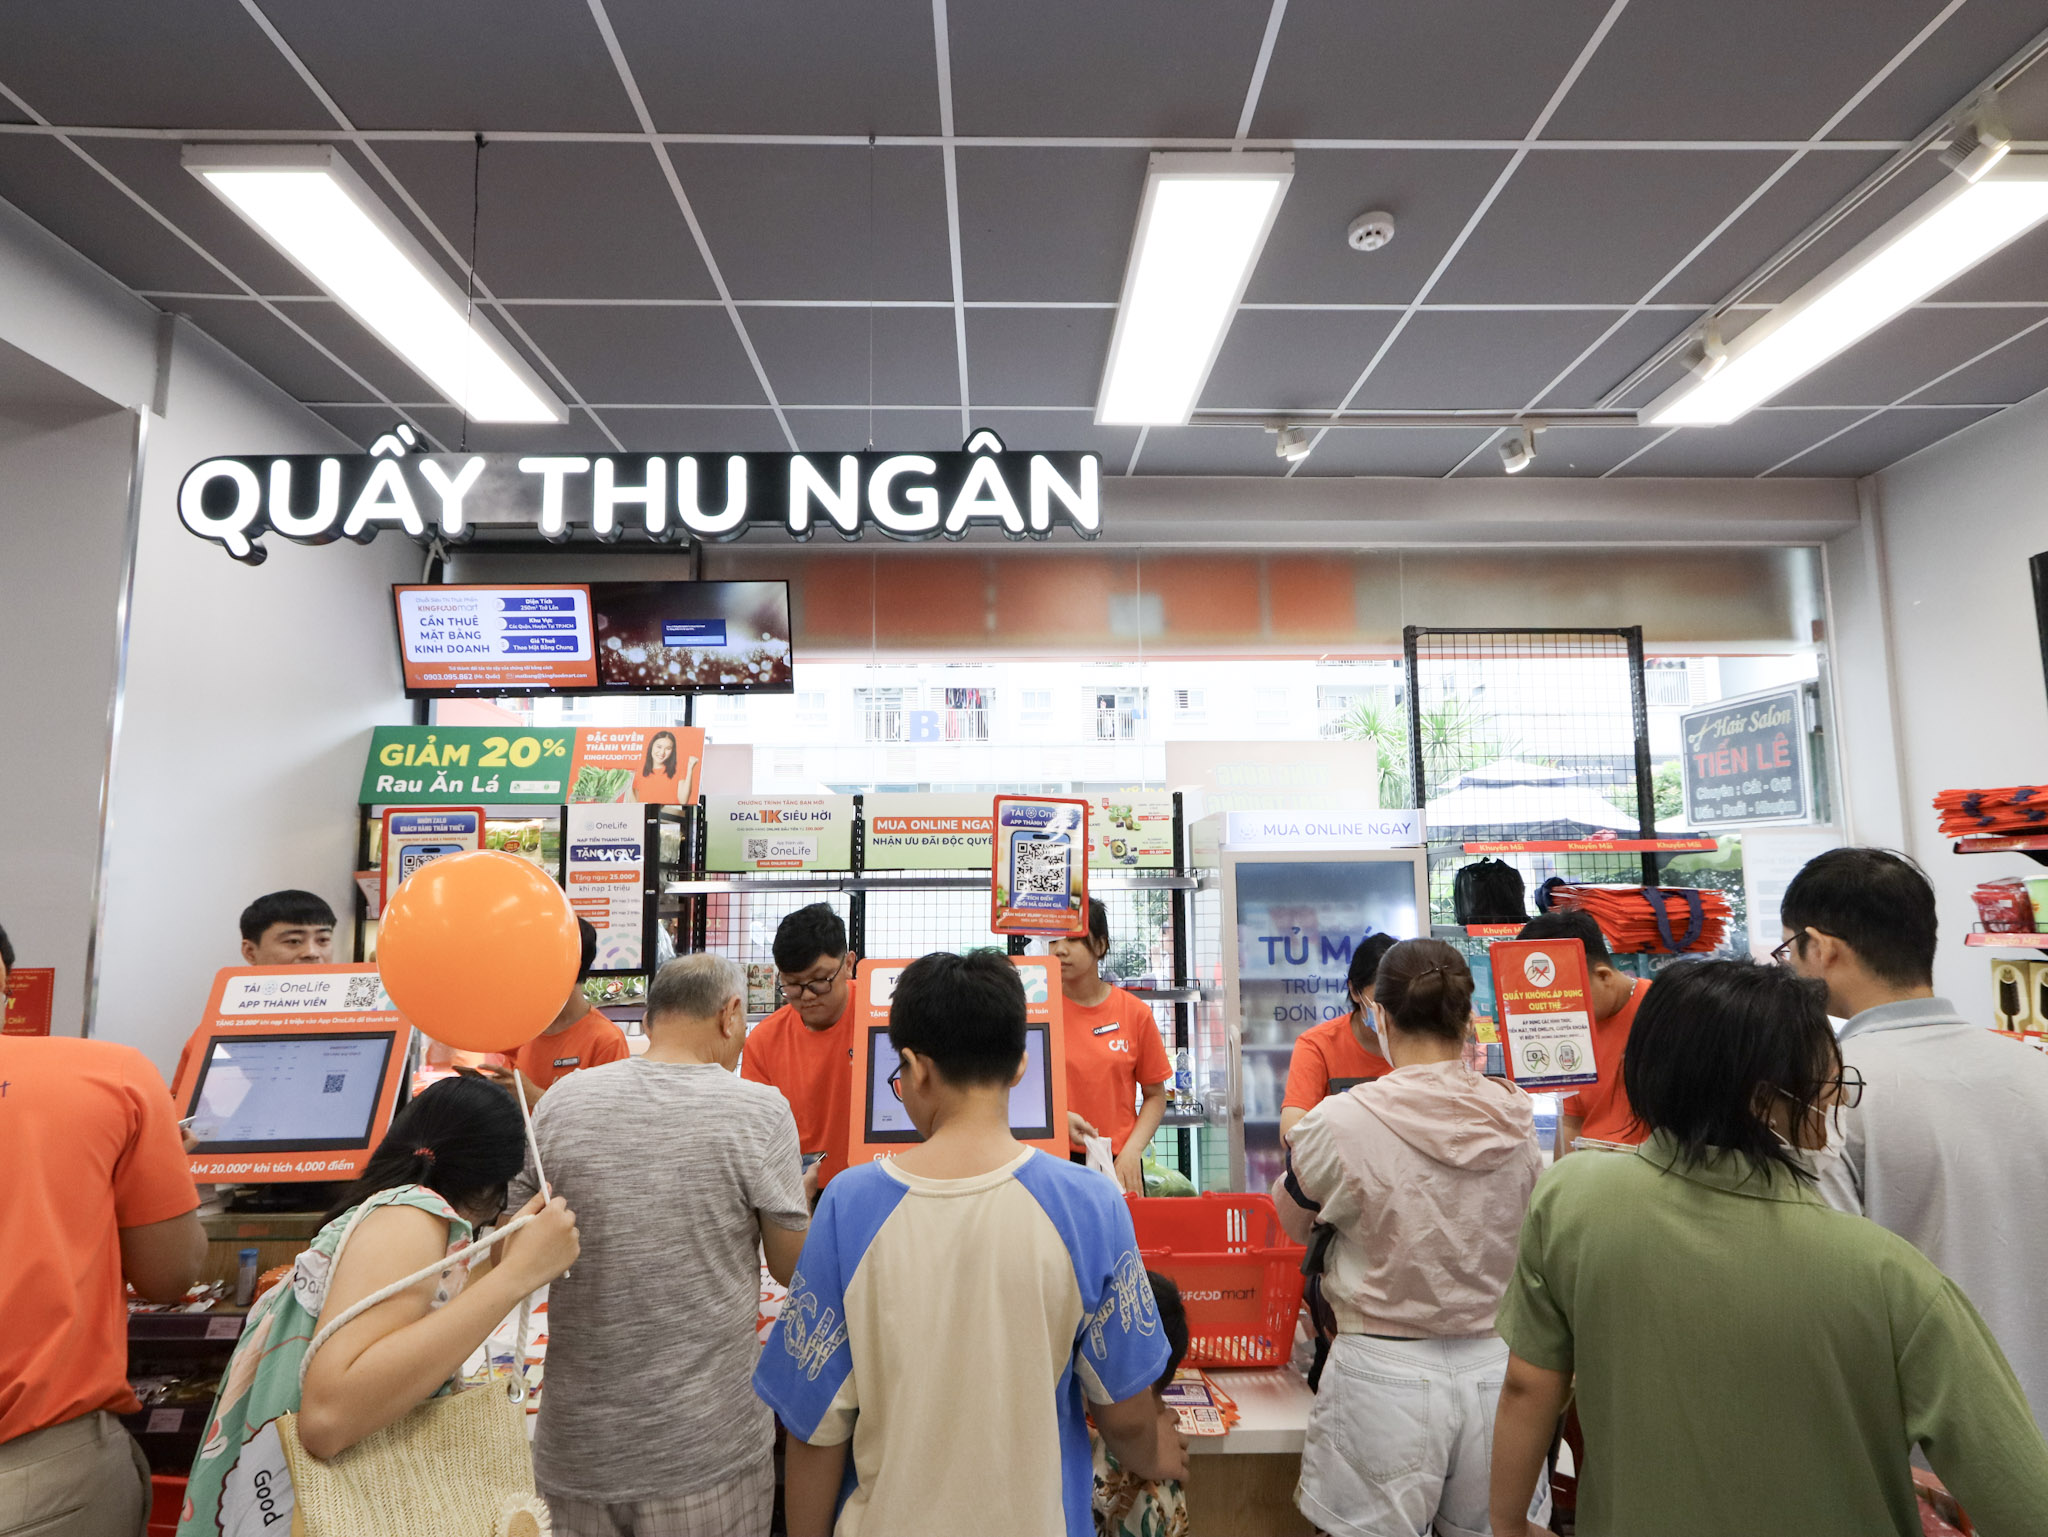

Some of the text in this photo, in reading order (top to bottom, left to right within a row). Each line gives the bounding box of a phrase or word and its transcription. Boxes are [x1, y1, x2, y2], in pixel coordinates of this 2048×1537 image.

[179, 423, 1100, 558] QUẦY THU NGÂN
[447, 614, 479, 626] THUÊ
[420, 627, 482, 643] MẶT BẰNG
[414, 644, 490, 654] KINH DOANH
[909, 710, 941, 743] B
[1713, 703, 1792, 739] Hair Salon
[586, 730, 644, 744] ĐẶC QUYỀN
[379, 734, 566, 768] GIẢM 20%
[586, 742, 643, 751] THÀNH VIÊN
[1693, 731, 1792, 779] TIẾN LÊ
[375, 770, 500, 793] Rau Ăn Lá
[729, 809, 832, 824] DEAL 1K SIÊU HỜI
[1009, 808, 1024, 817] TẢI
[595, 821, 628, 830] OneLife
[876, 819, 907, 830] MUA
[910, 819, 959, 830] ONLINE
[1263, 822, 1411, 836] MUA ONLINE NGAY
[872, 835, 964, 848] NHẬN ƯU ĐÃI ĐỘC
[1479, 843, 1525, 852] Khuyến Mãi
[1567, 841, 1614, 851] Khuyến Mãi
[1656, 841, 1687, 849] Khuyến
[770, 846, 811, 856] OneLife
[574, 874, 592, 882] Tặng
[613, 884, 631, 892] triệu
[1483, 926, 1512, 935] Khuyến
[1258, 926, 1309, 965] TỦ
[243, 981, 331, 993] TẢI OneLife
[1280, 974, 1322, 994] TRỮ
[238, 998, 327, 1009] APP THÀNH VIÊN
[869, 1010, 888, 1019] TẶNG
[1272, 1003, 1317, 1022] ĐƠN
[873, 1149, 897, 1161] GIẢ
[189, 1161, 209, 1174] ẢM
[253, 1163, 271, 1173] khi
[272, 1161, 292, 1173] tích
[294, 1160, 326, 1174] 4,000
[327, 1158, 355, 1171] điểm
[1179, 1287, 1256, 1301] FOODmart
[254, 1469, 284, 1528] Good
